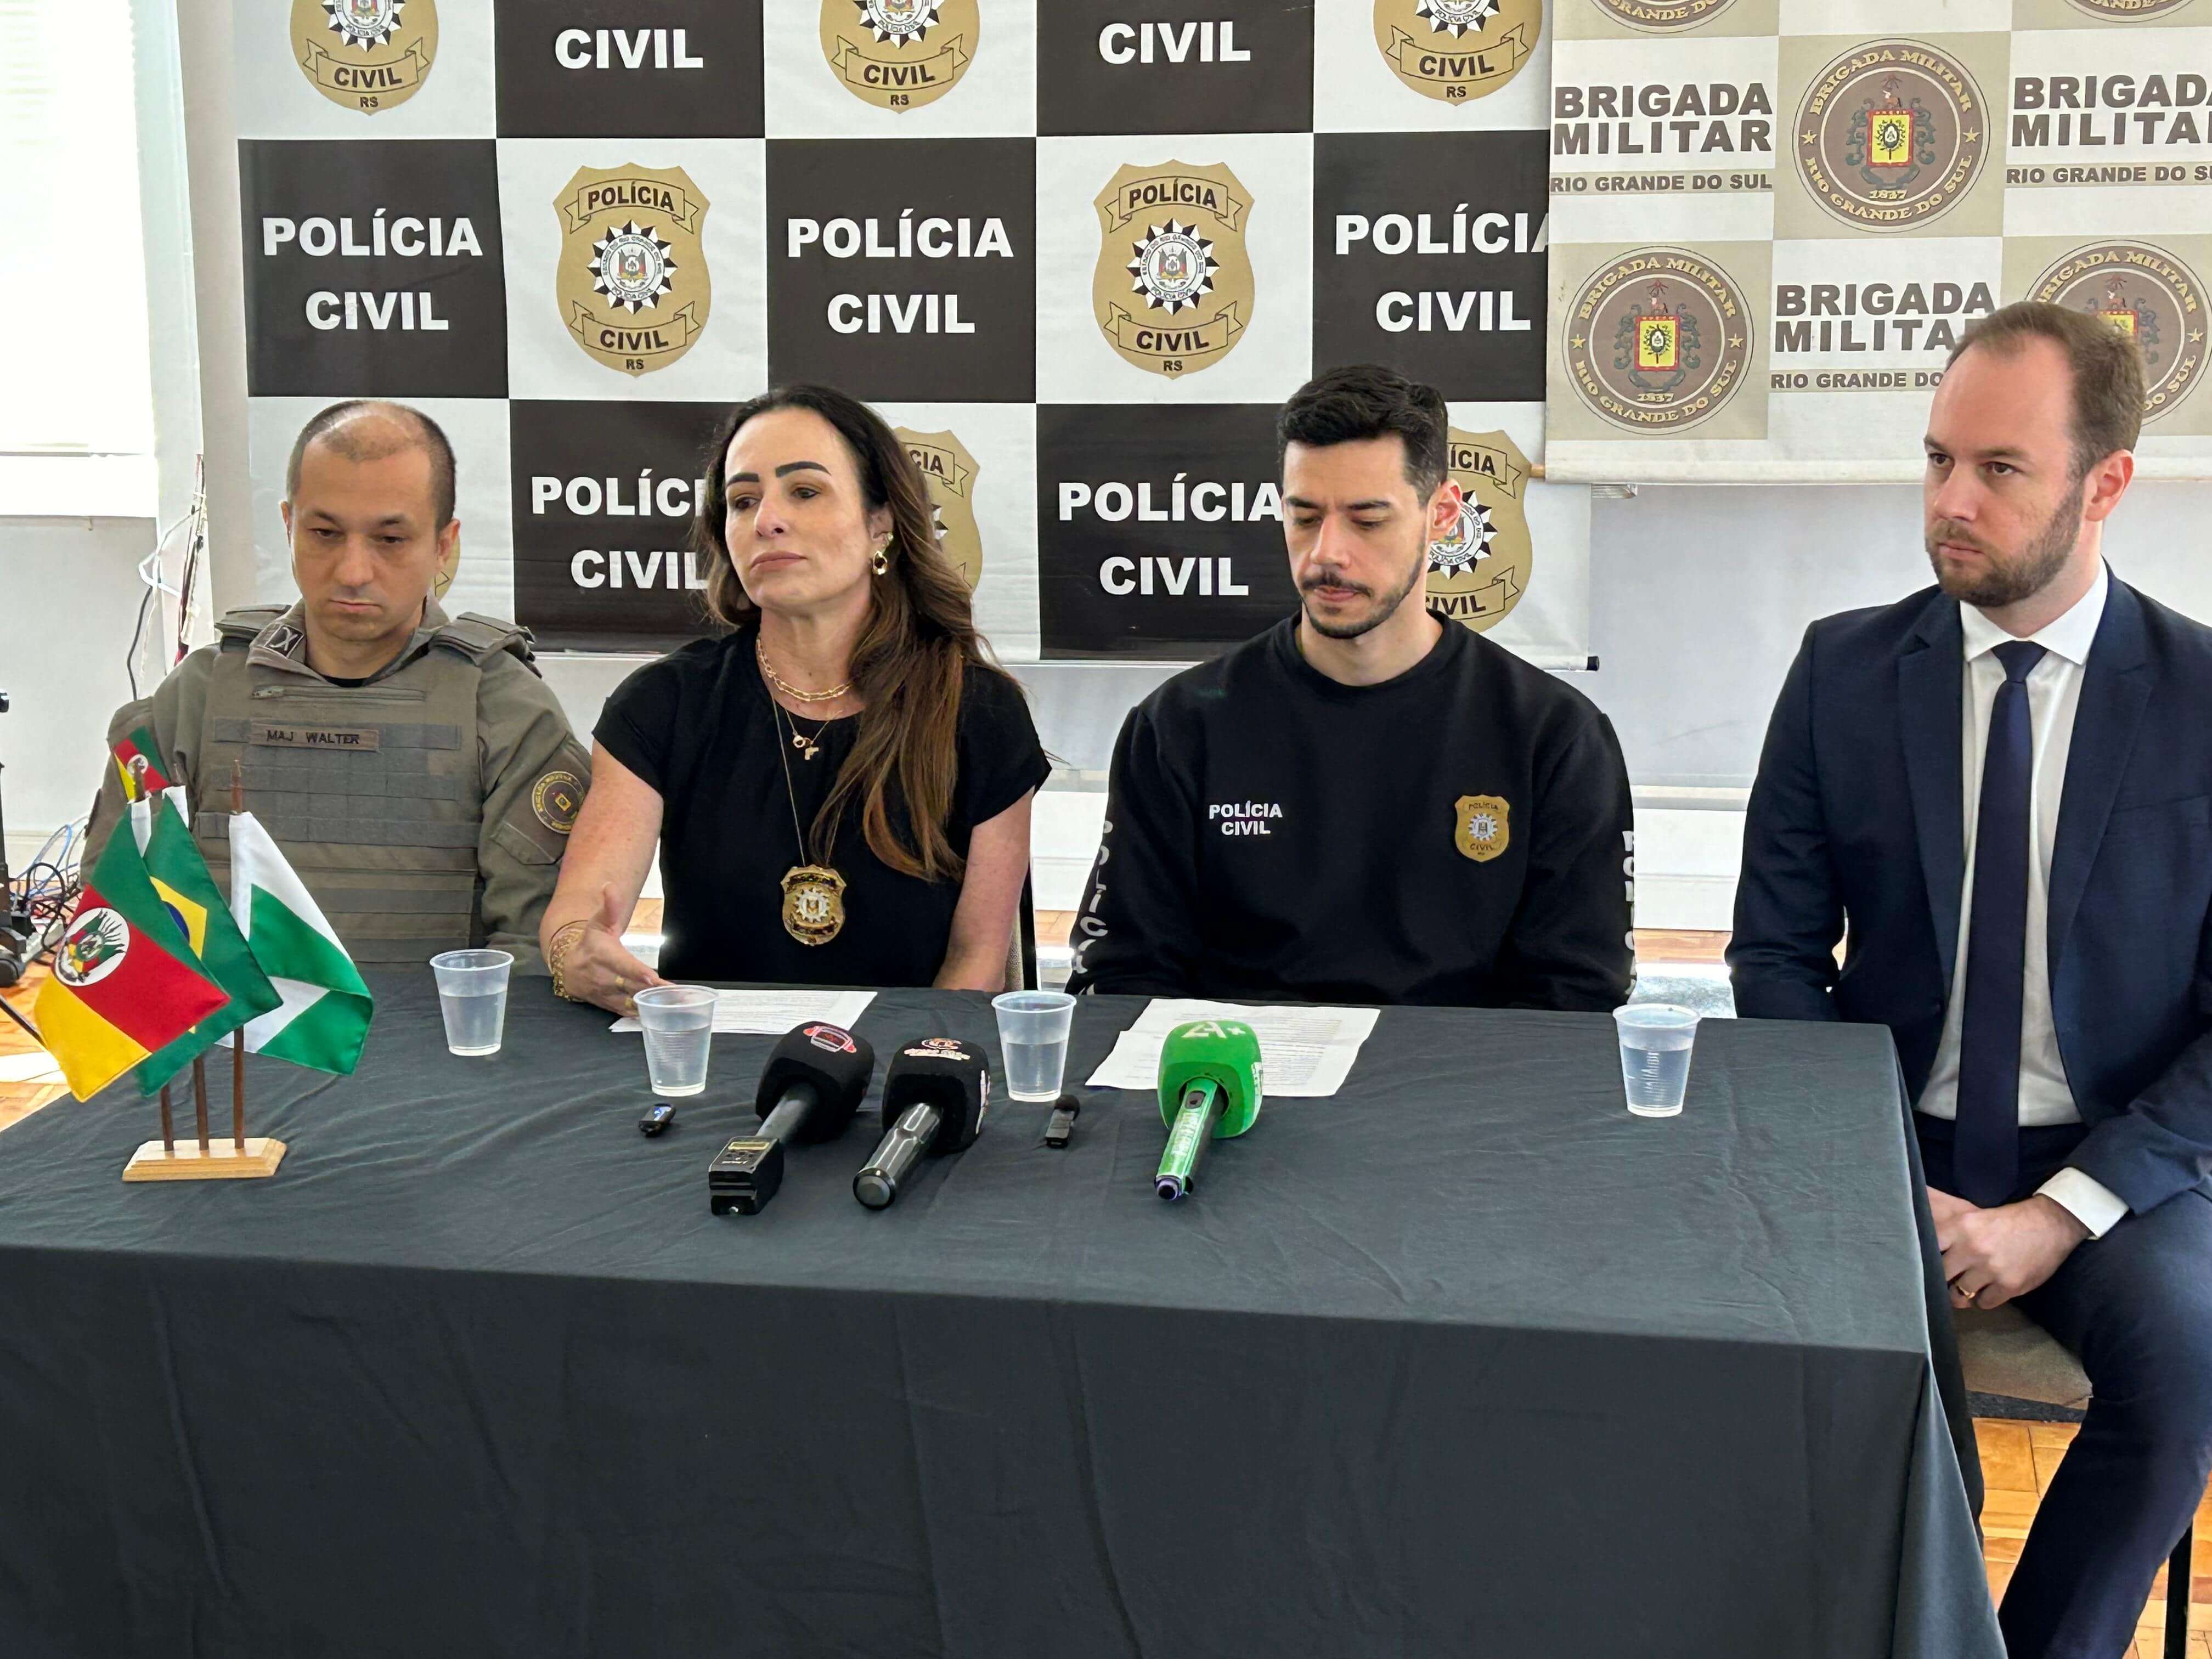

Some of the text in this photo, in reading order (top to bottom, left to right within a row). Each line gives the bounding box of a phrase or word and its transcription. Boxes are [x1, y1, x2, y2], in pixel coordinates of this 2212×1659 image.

[555, 29, 703, 70] CIVIL
[1099, 21, 1250, 64] CIVIL
[334, 68, 402, 89] CIVIL
[863, 64, 936, 86] CIVIL
[1419, 55, 1494, 77] CIVIL
[1810, 50, 1972, 115] BRIGADA MILITAR
[360, 97, 379, 108] RS
[890, 94, 910, 106] RS
[1446, 86, 1466, 98] RS
[1555, 83, 1772, 119] BRIGADA
[2014, 75, 2212, 109] BRIGAD
[1554, 120, 1771, 155] MILITAR
[2012, 111, 2212, 147] MILITA
[1551, 173, 1772, 193] RIO GRANDE DO SUL
[1805, 155, 1972, 220] RIO GRANDE DO SUL
[2006, 168, 2045, 184] RIO
[2052, 166, 2146, 183] GRANDE
[2155, 166, 2186, 181] DO
[588, 181, 675, 211] POLÍCIA
[1129, 179, 1217, 209] POLÍCIA
[263, 208, 482, 257] POLÍCIA
[788, 208, 1013, 258] POLÍCIA
[1578, 257, 1737, 320] BRIGADA MILITAR
[2126, 251, 2198, 313] MILITAR
[306, 292, 449, 330] CIVIL
[827, 294, 975, 334] CIVIL
[1376, 291, 1531, 332] CIVIL
[1776, 283, 1996, 317] BRIGADA
[600, 328, 669, 351] CIVIL
[1136, 330, 1209, 352] CIVIL
[1774, 319, 1982, 352] MILITA
[626, 359, 644, 371] RS
[1163, 360, 1183, 371] RS
[1770, 372, 1944, 389] RIO GRANDE DO
[2167, 355, 2196, 393] SUL
[1575, 360, 1737, 422] RIO GRANDE DO SUL
[532, 469, 706, 517] POLÍCI
[1059, 472, 1283, 522] POLÍCIA
[571, 550, 709, 589] CIVIL
[1100, 556, 1249, 596] CIVIL
[1426, 595, 1486, 615] IVIL
[267, 730, 360, 744] MAJ WALTER
[1209, 800, 1283, 819] POLÍCIA
[1221, 821, 1271, 836] CIVIL
